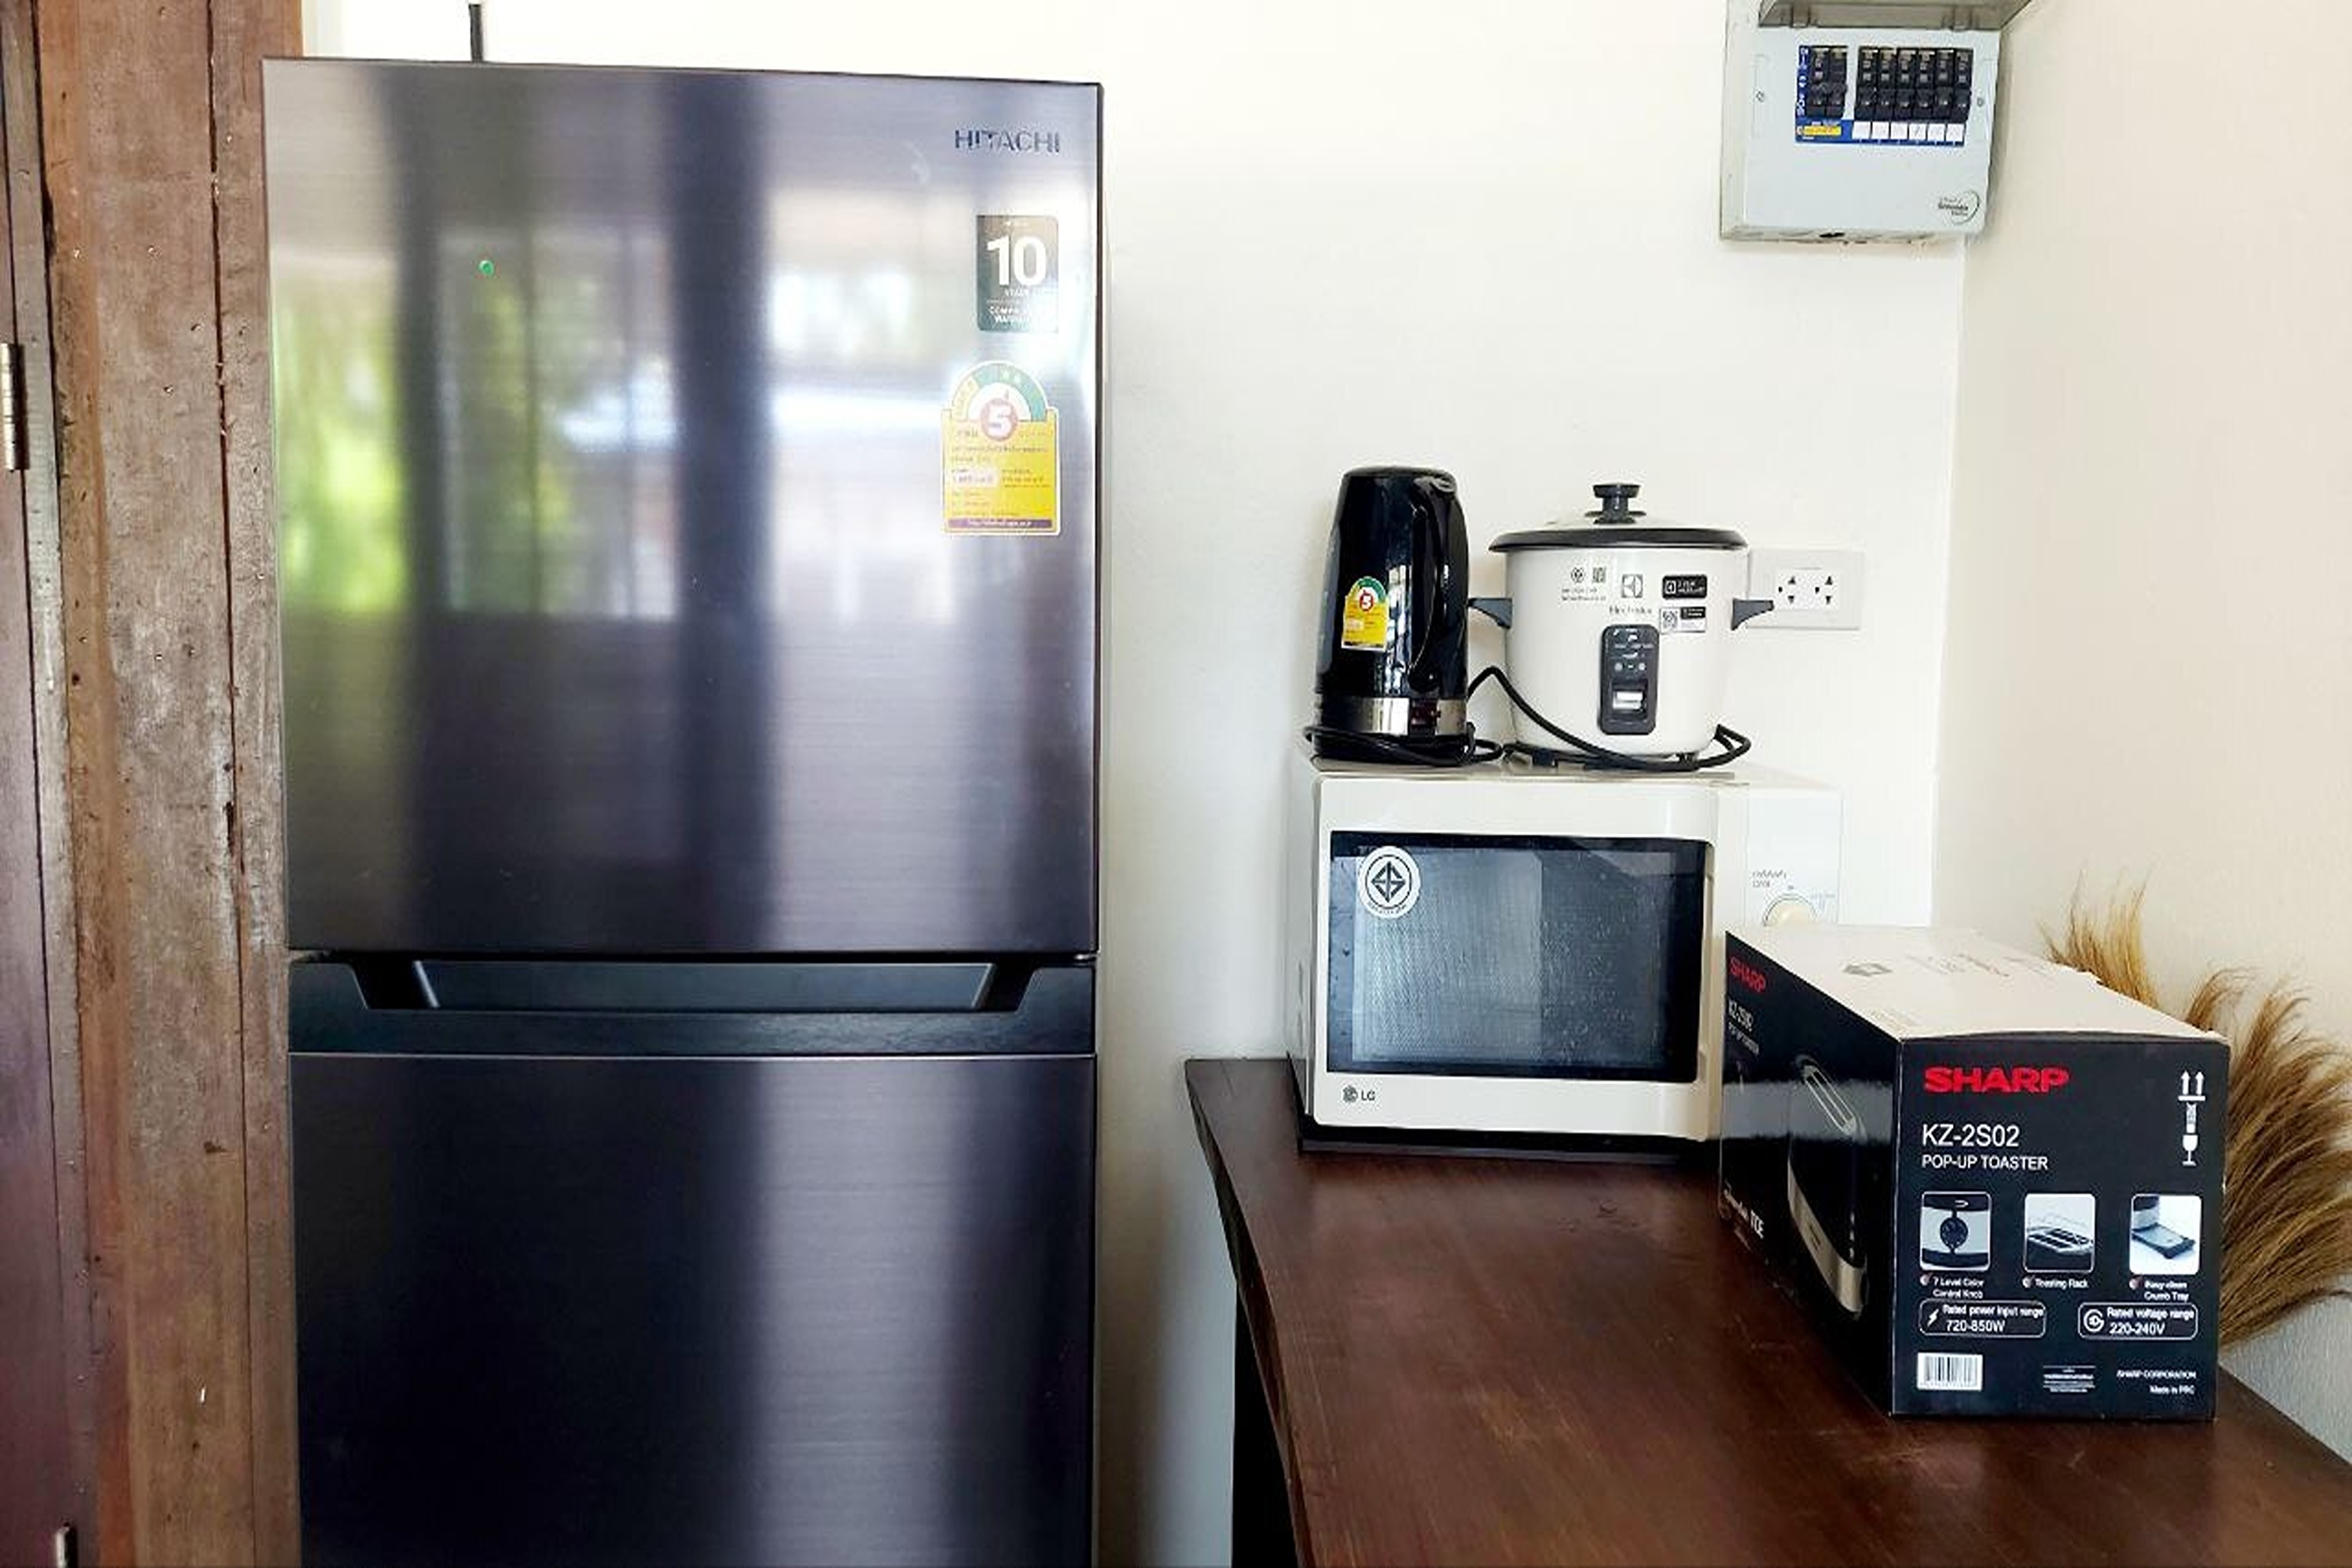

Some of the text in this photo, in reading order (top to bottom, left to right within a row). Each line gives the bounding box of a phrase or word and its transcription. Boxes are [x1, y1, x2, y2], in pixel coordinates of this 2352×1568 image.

[954, 129, 1060, 152] HITACHI
[986, 234, 1047, 286] 10
[987, 402, 1014, 437] 5
[1925, 1067, 2070, 1092] SHARP
[1361, 1090, 1375, 1101] LG
[1922, 1123, 2020, 1147] KZ-2S02
[1922, 1154, 2049, 1171] POP-UP TOASTER
[1940, 1278, 1961, 1287] Level
[1963, 1278, 1984, 1287] Color
[2069, 1278, 2089, 1288] Rack
[1943, 1305, 1967, 1315] Rated
[1969, 1306, 1995, 1316] power
[1997, 1306, 2018, 1318] input
[2169, 1311, 2194, 1320] range
[1947, 1319, 2005, 1332] 720-850W
[2109, 1322, 2165, 1334] 220-240V
